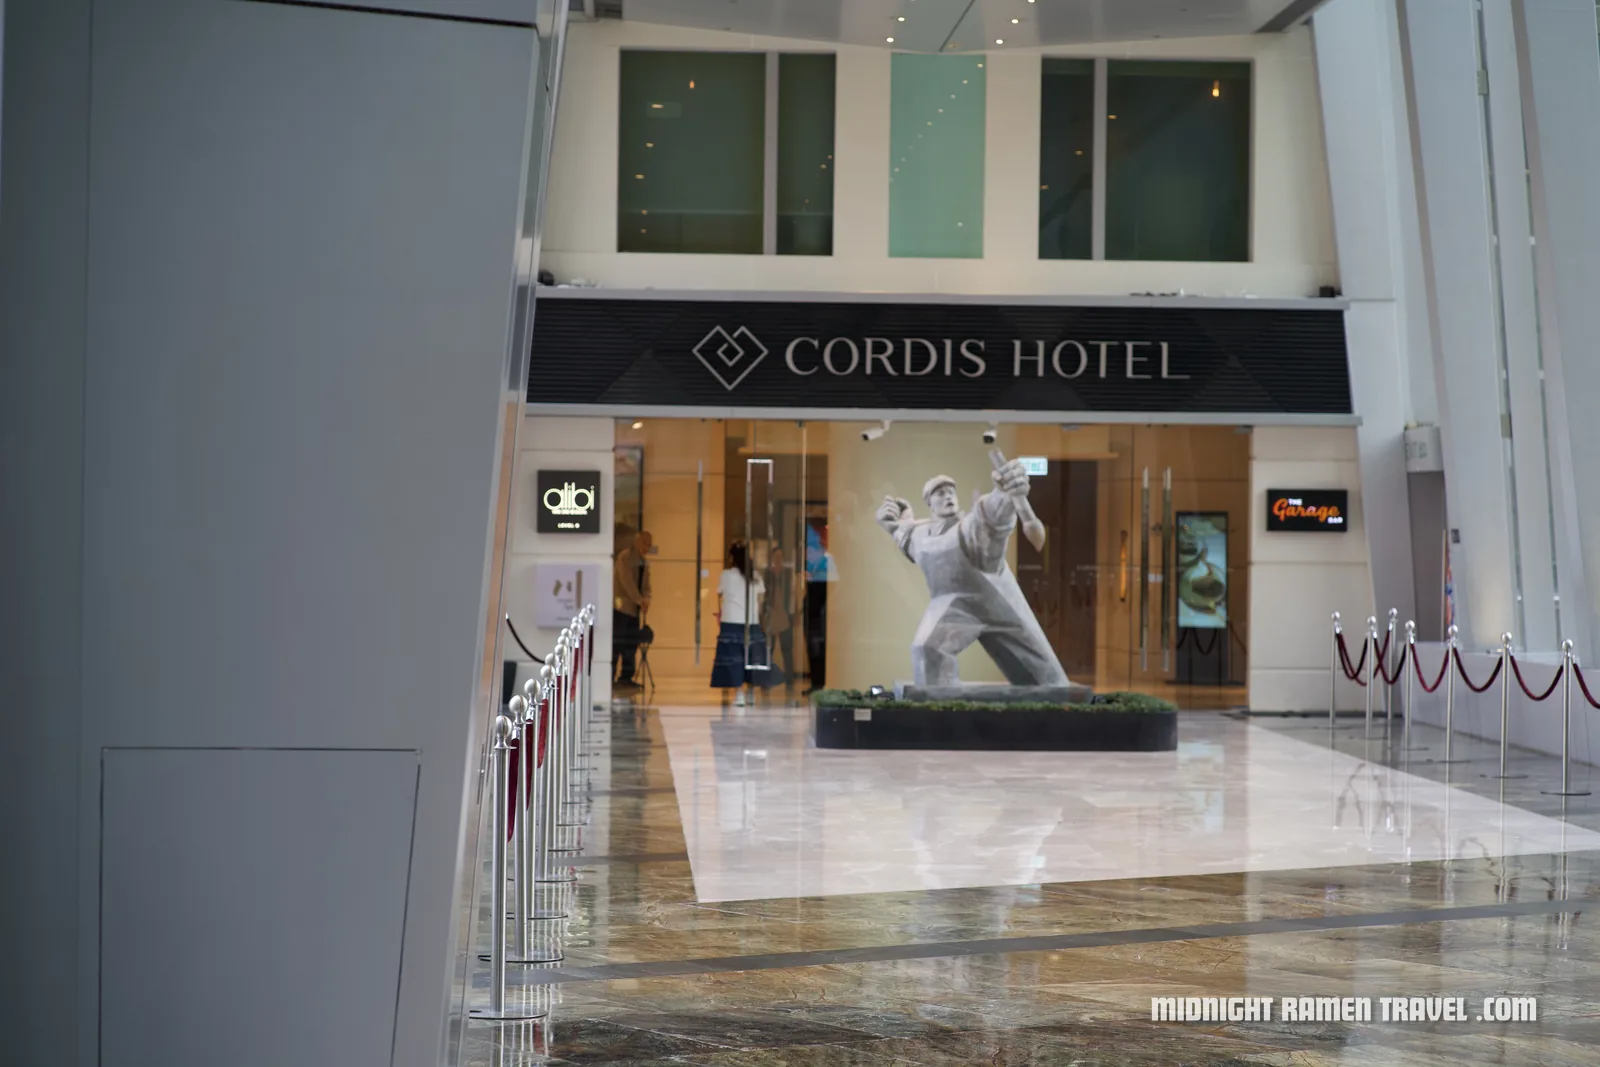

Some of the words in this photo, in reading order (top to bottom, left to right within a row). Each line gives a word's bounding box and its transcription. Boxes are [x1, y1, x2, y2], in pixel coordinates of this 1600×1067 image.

[784, 336, 987, 378] CORDIS
[1012, 339, 1191, 379] HOTEL
[1272, 497, 1340, 523] Garage
